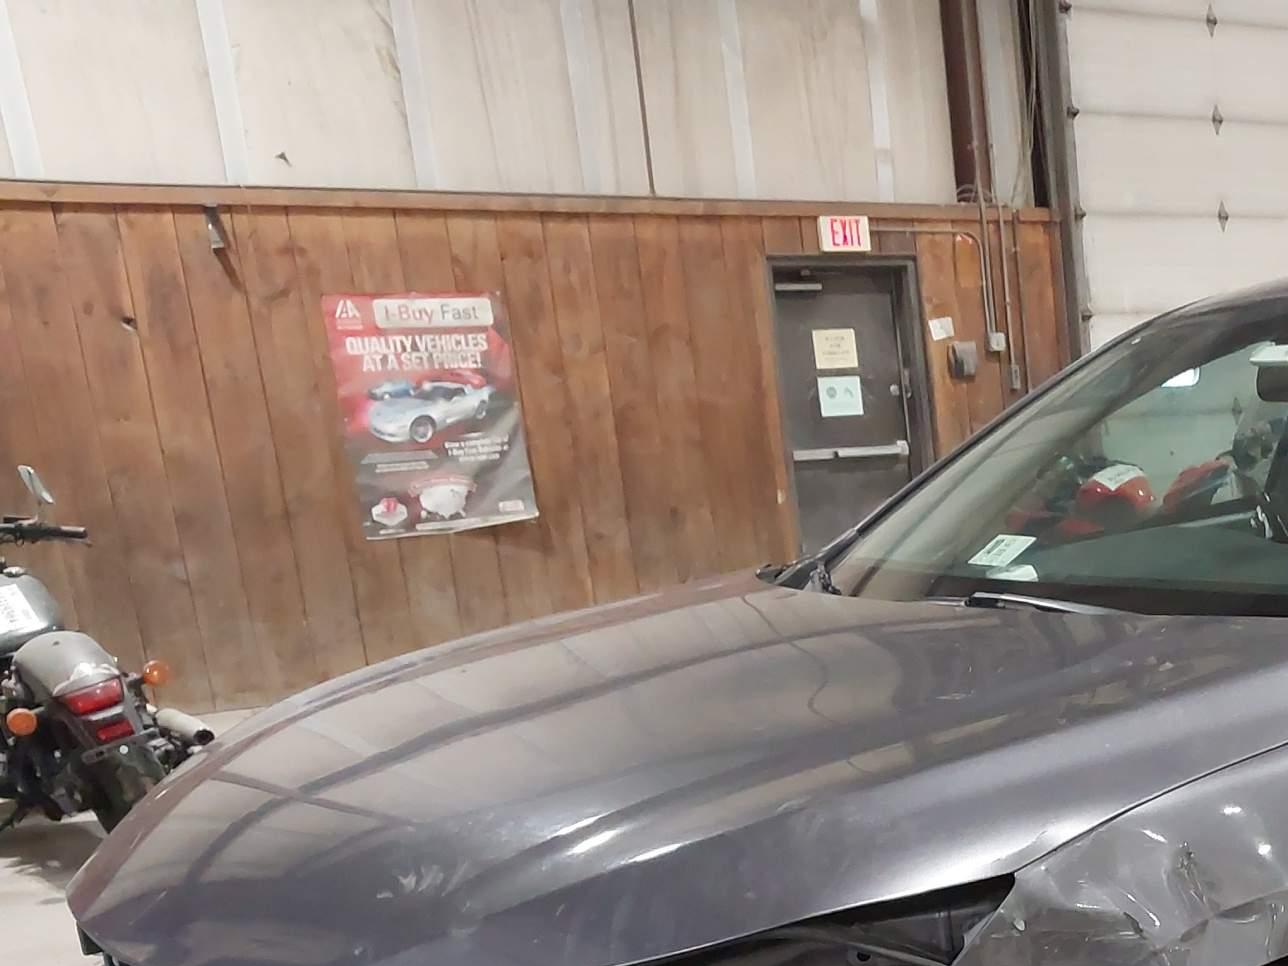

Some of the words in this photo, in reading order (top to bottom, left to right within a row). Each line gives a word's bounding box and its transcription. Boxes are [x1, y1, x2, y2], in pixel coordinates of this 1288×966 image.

[830, 218, 861, 247] EXIT
[384, 304, 433, 325] I-Buy
[440, 303, 479, 321] Fast
[345, 335, 412, 355] QUALITY
[414, 333, 488, 353] VEHICLES
[362, 355, 383, 372] AT
[387, 353, 400, 371] A
[400, 351, 430, 370] SET
[431, 350, 483, 370] PRICE!
